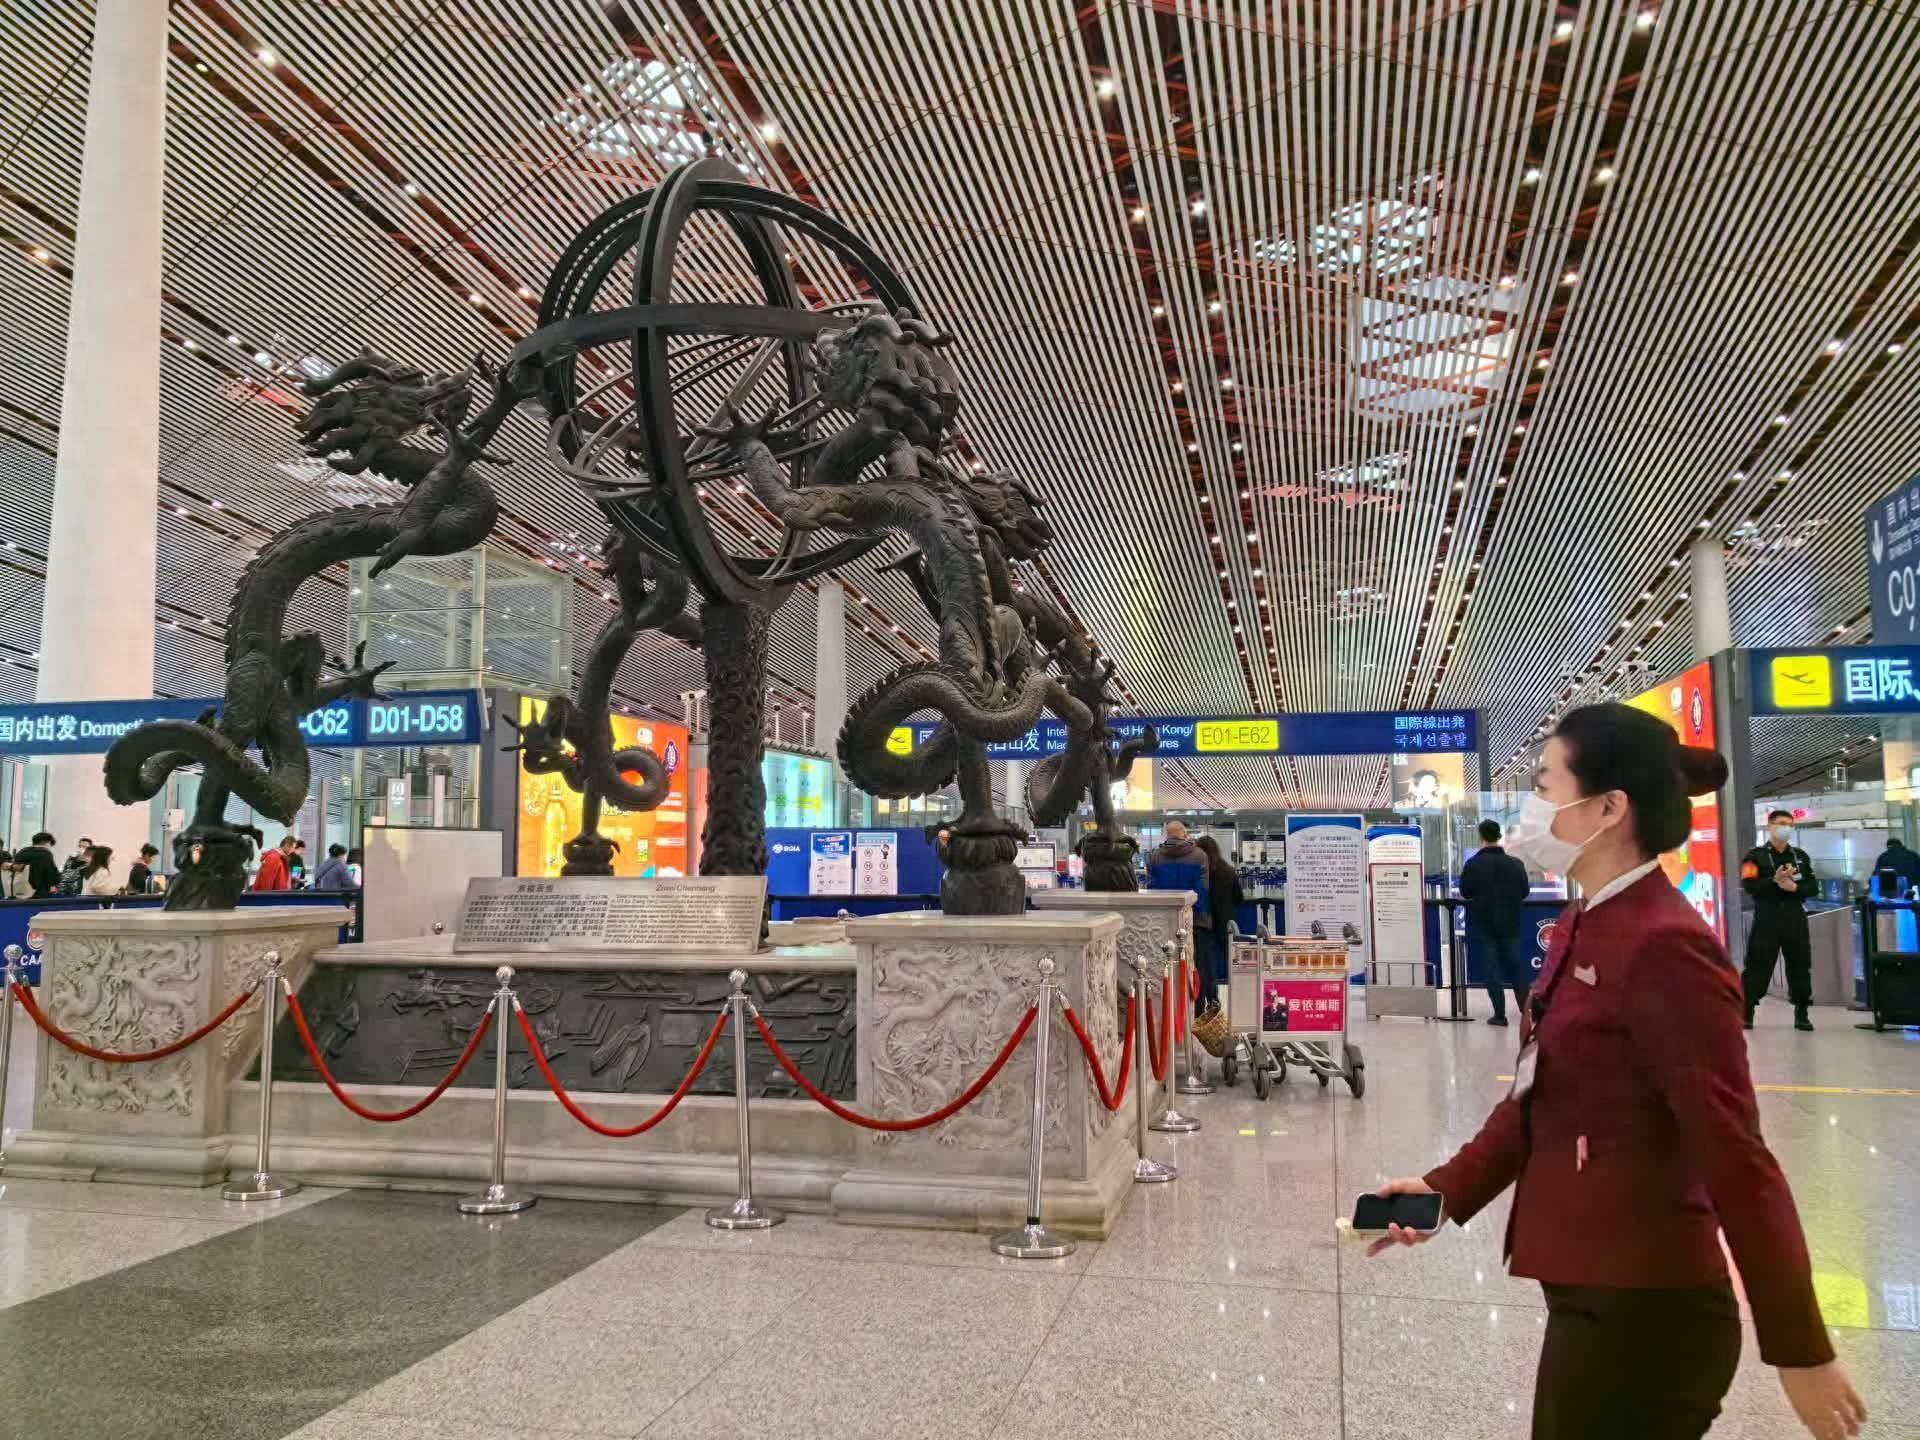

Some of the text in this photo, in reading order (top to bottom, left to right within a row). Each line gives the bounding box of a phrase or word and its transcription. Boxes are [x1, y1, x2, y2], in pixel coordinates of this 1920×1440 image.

[0, 714, 78, 741] 国内出发
[300, 708, 348, 735] -C62
[370, 705, 463, 734] D01-D58
[1395, 715, 1465, 730] 国際線出発
[1202, 727, 1270, 746] E01-E62
[1394, 732, 1467, 748] 국제선출발
